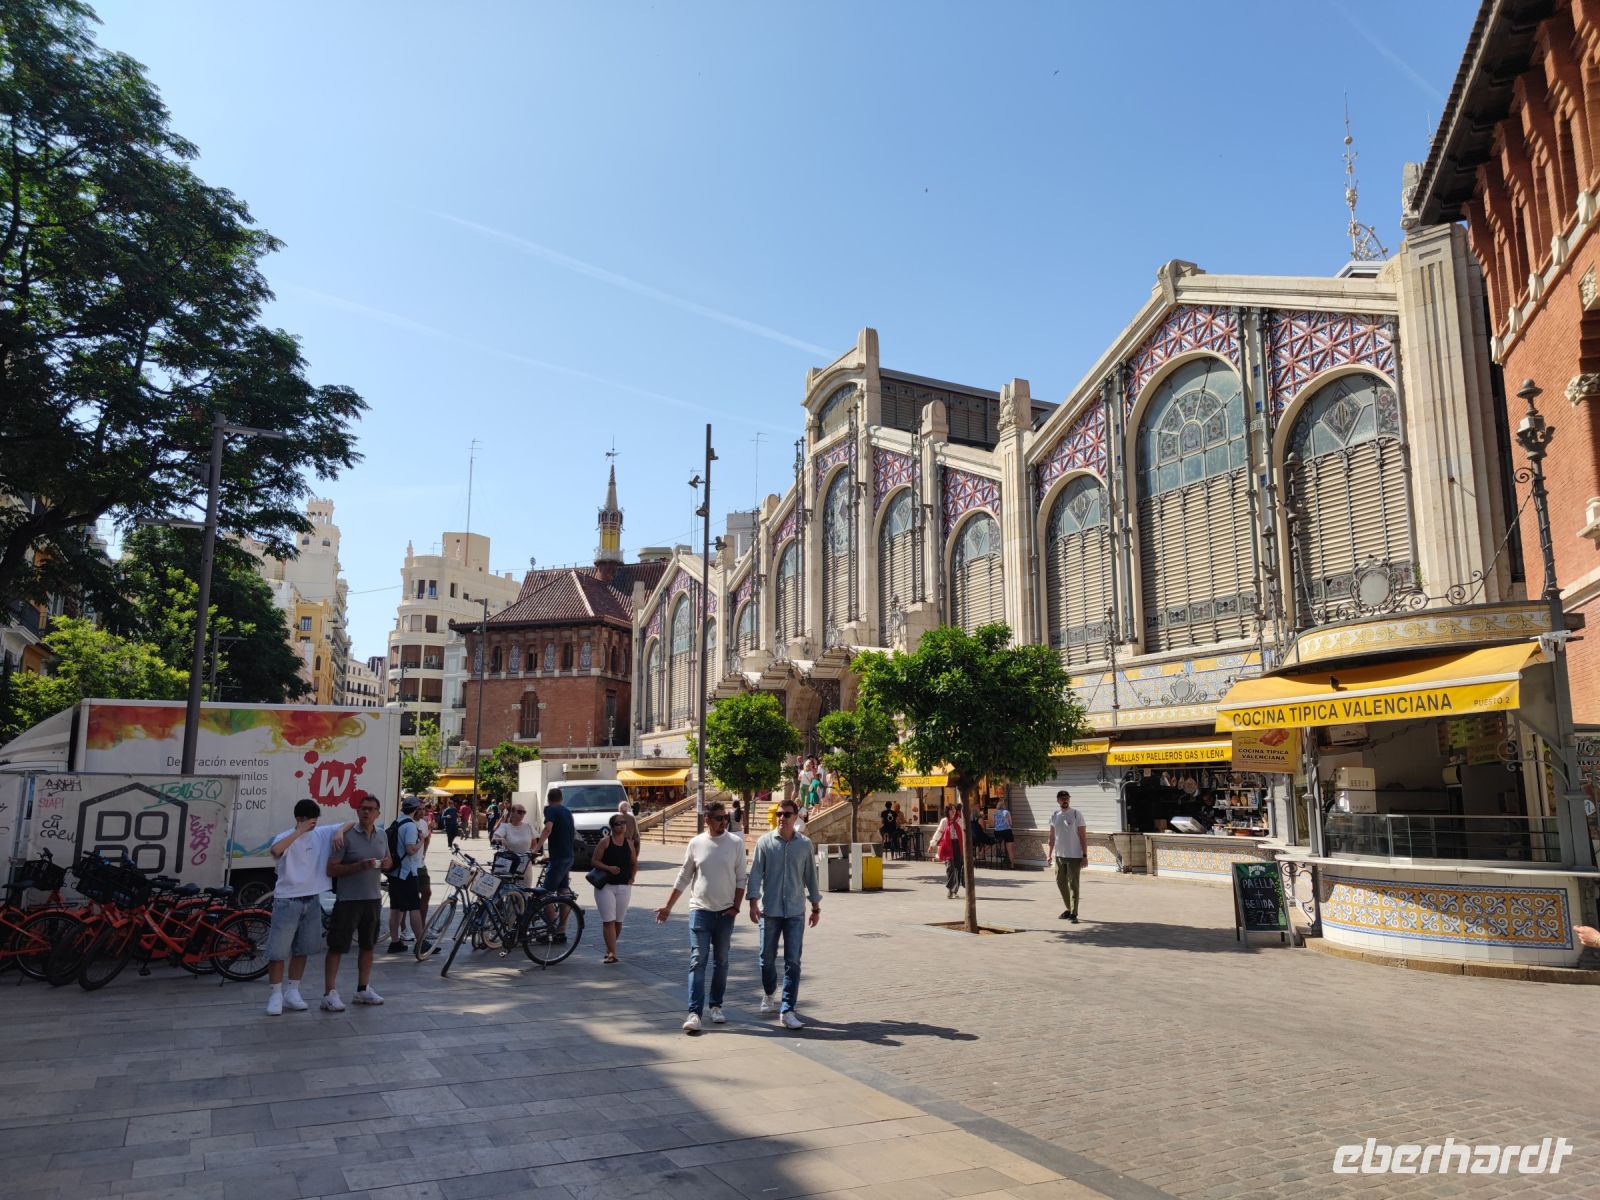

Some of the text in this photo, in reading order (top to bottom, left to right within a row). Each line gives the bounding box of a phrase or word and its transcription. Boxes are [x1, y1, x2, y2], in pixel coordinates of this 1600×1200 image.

[1474, 696, 1510, 706] PUESTO 2
[1233, 693, 1452, 727] COCINA TIPICA VALENCIANA
[1114, 748, 1225, 763] PAELLAS Y PAELLEROS GAS Y LEÑA
[230, 758, 269, 767] eventos
[241, 771, 268, 781] inilos
[245, 800, 266, 811] CNC
[1243, 878, 1276, 889] PAELLA
